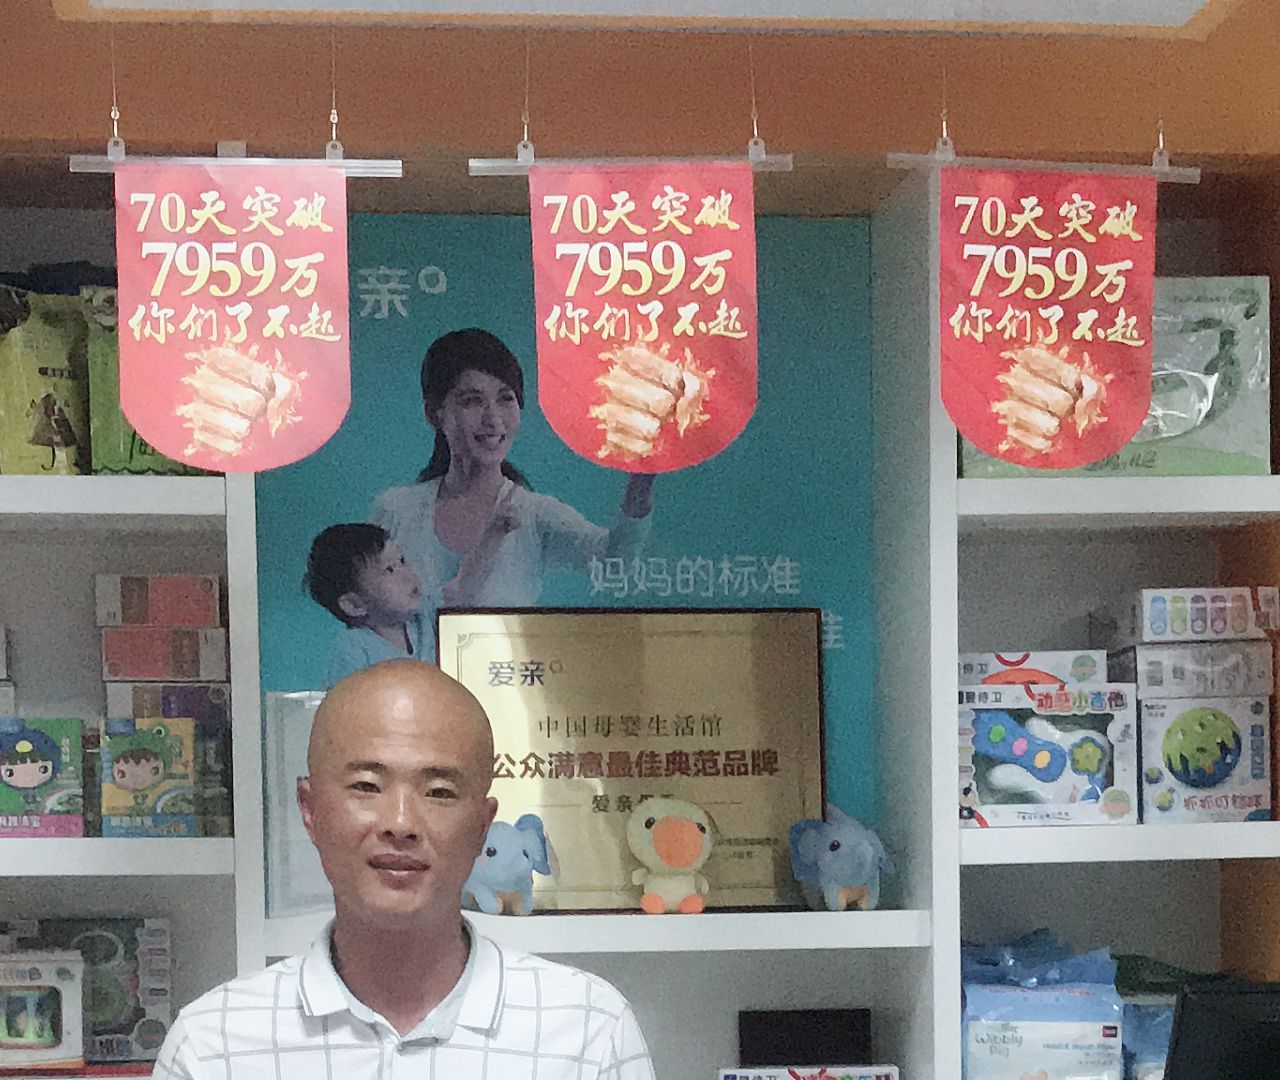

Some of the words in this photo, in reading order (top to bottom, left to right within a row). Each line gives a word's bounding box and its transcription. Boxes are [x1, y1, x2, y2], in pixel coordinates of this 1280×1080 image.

[130, 187, 333, 235] 70天突破
[543, 186, 740, 235] 70天突破
[954, 194, 1143, 242] 70天突破
[141, 241, 325, 298] 7959万
[555, 240, 732, 296] 7959万
[962, 244, 1133, 303] 7959万
[128, 301, 342, 344] 你们了不起
[544, 299, 748, 345] 你们了不起
[949, 301, 1145, 346] 你们了不起
[588, 555, 801, 598] 妈妈的标准
[488, 660, 546, 687] 爱亲
[538, 713, 724, 739] 中国母婴生活馆
[493, 750, 780, 779] 公众满意最佳典范品牌
